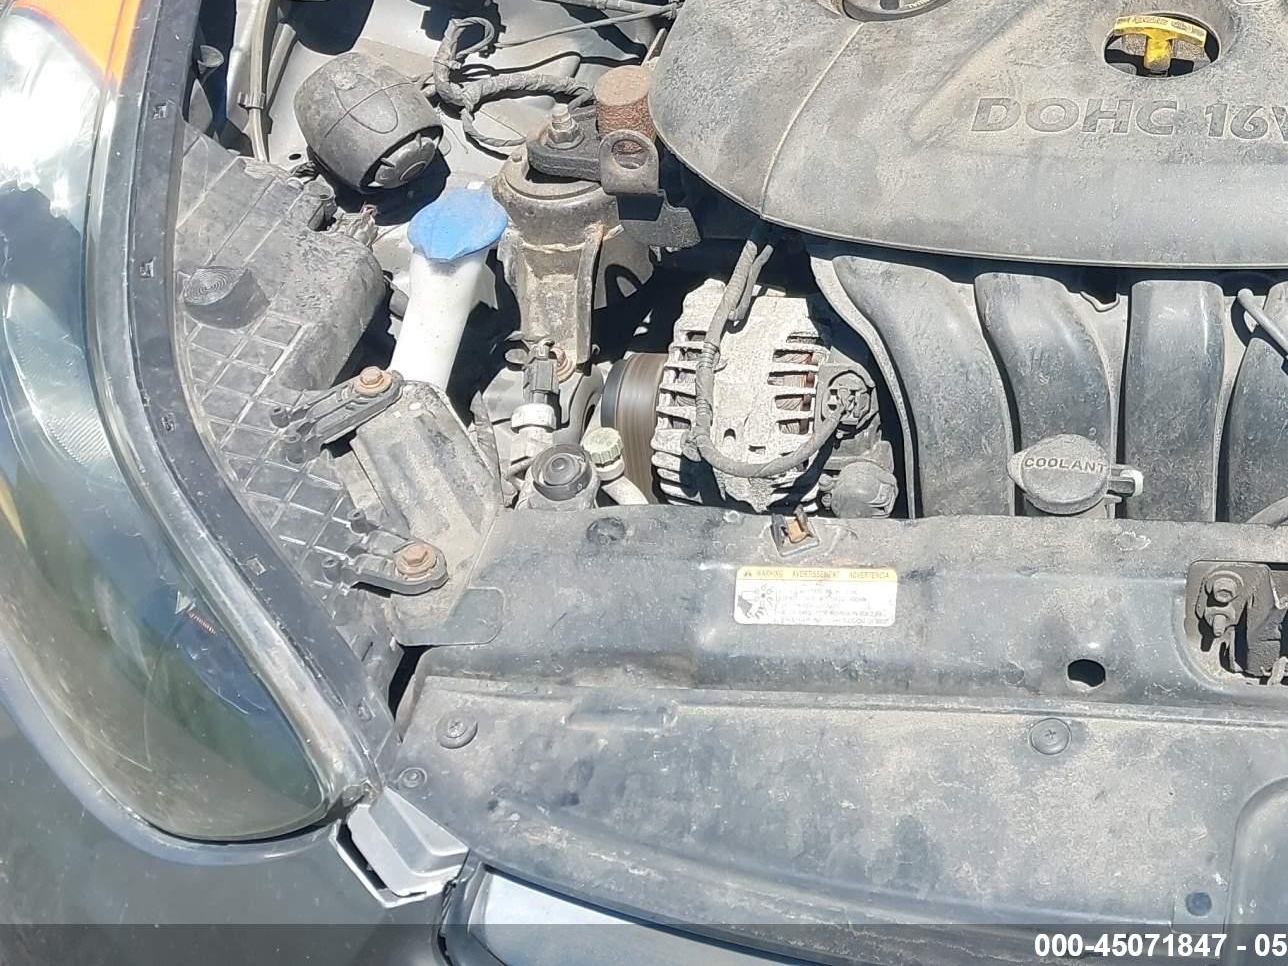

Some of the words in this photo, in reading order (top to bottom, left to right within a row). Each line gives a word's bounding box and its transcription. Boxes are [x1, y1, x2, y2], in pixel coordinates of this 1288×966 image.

[971, 96, 1178, 137] DOHC
[1025, 456, 1107, 473] COOLANT
[756, 569, 785, 579] WARNING
